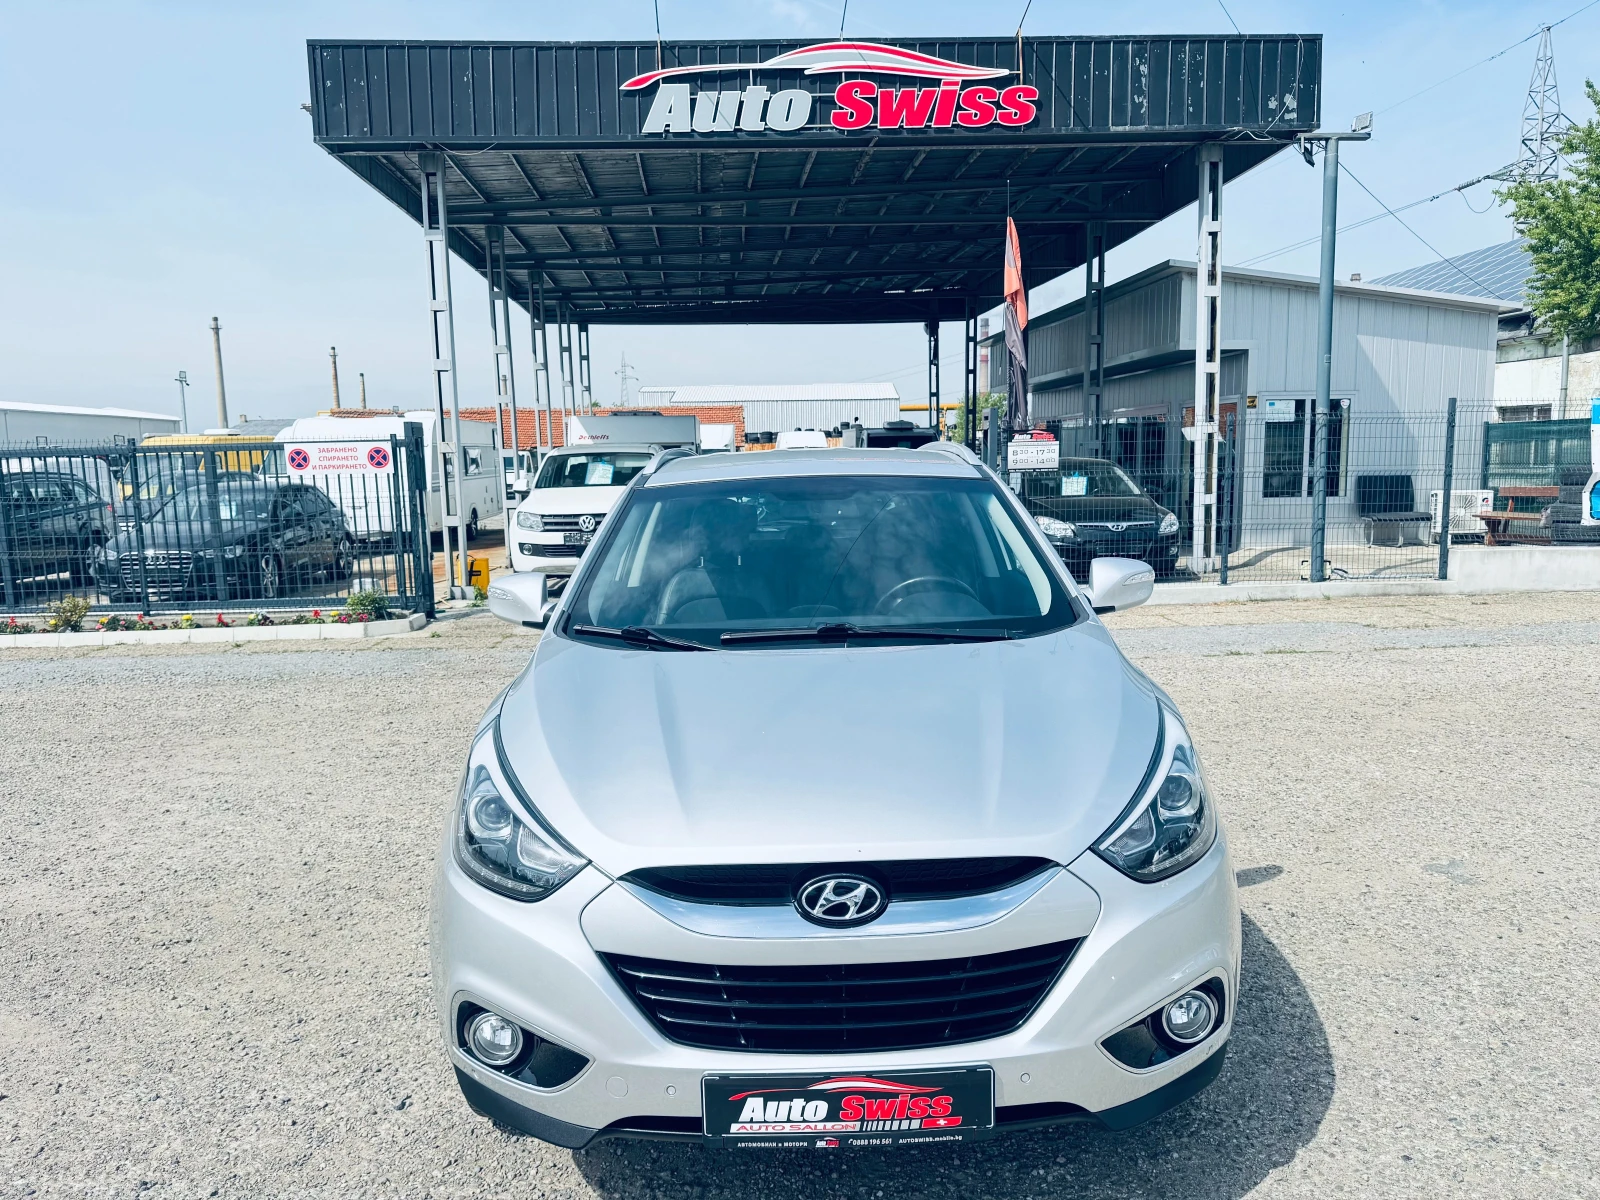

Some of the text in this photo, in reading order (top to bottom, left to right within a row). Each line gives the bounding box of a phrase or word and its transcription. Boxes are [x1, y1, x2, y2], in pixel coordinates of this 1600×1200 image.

[642, 80, 1039, 133] Auto Swiss
[738, 1094, 953, 1122] Auto Swiss
[736, 1123, 857, 1132] AUTO SALLON
